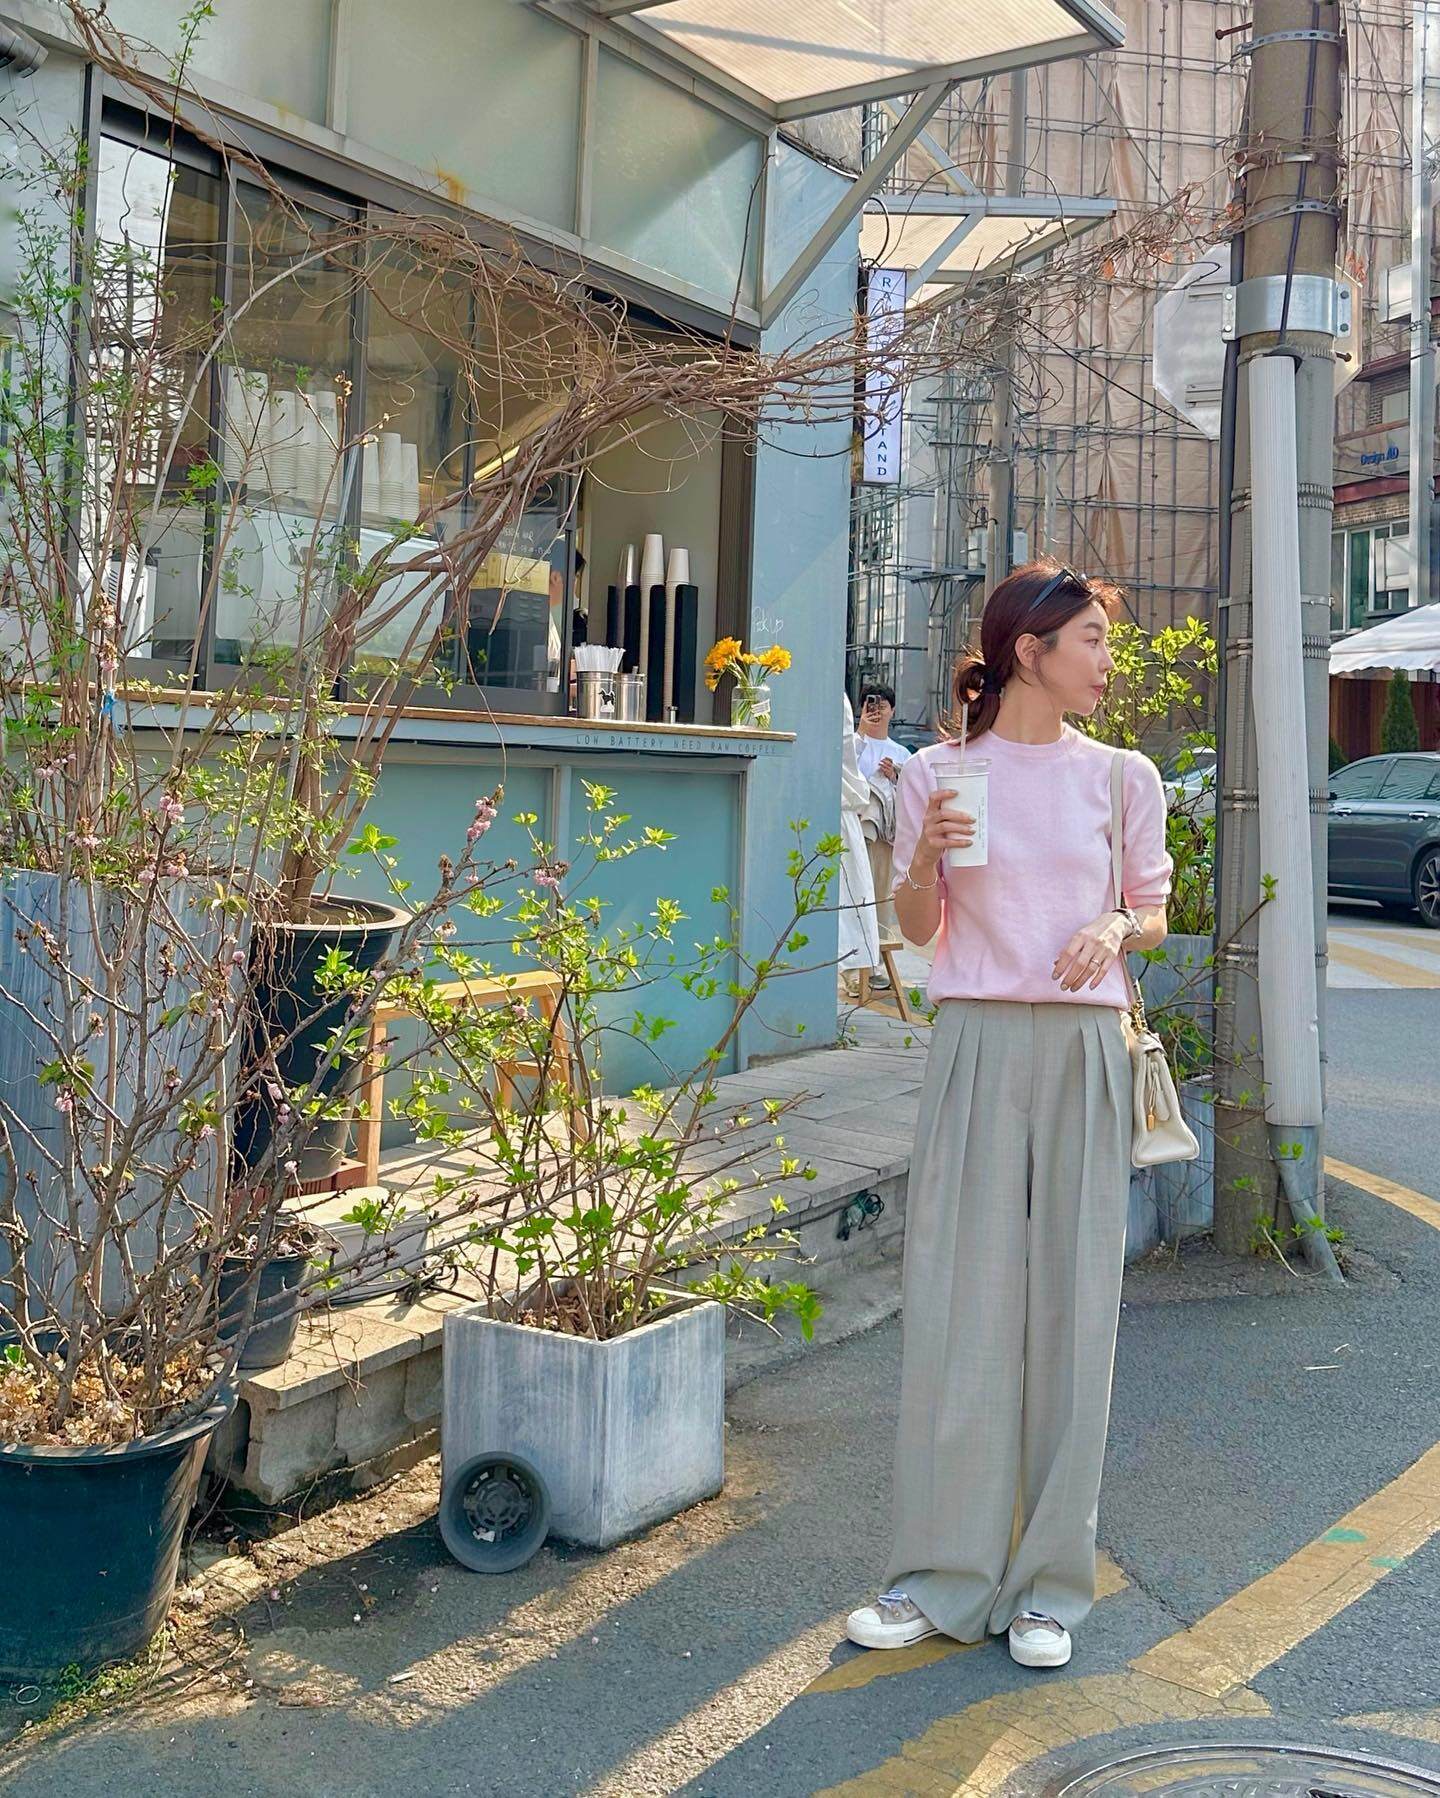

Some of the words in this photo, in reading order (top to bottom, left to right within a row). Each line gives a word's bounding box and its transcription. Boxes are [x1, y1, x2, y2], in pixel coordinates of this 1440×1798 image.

[877, 416, 888, 476] TAND
[576, 735, 599, 745] LOW
[610, 736, 664, 748] BATTERY
[673, 739, 702, 750] NEED
[711, 741, 730, 752] RAW
[738, 743, 777, 754] COFFEE
